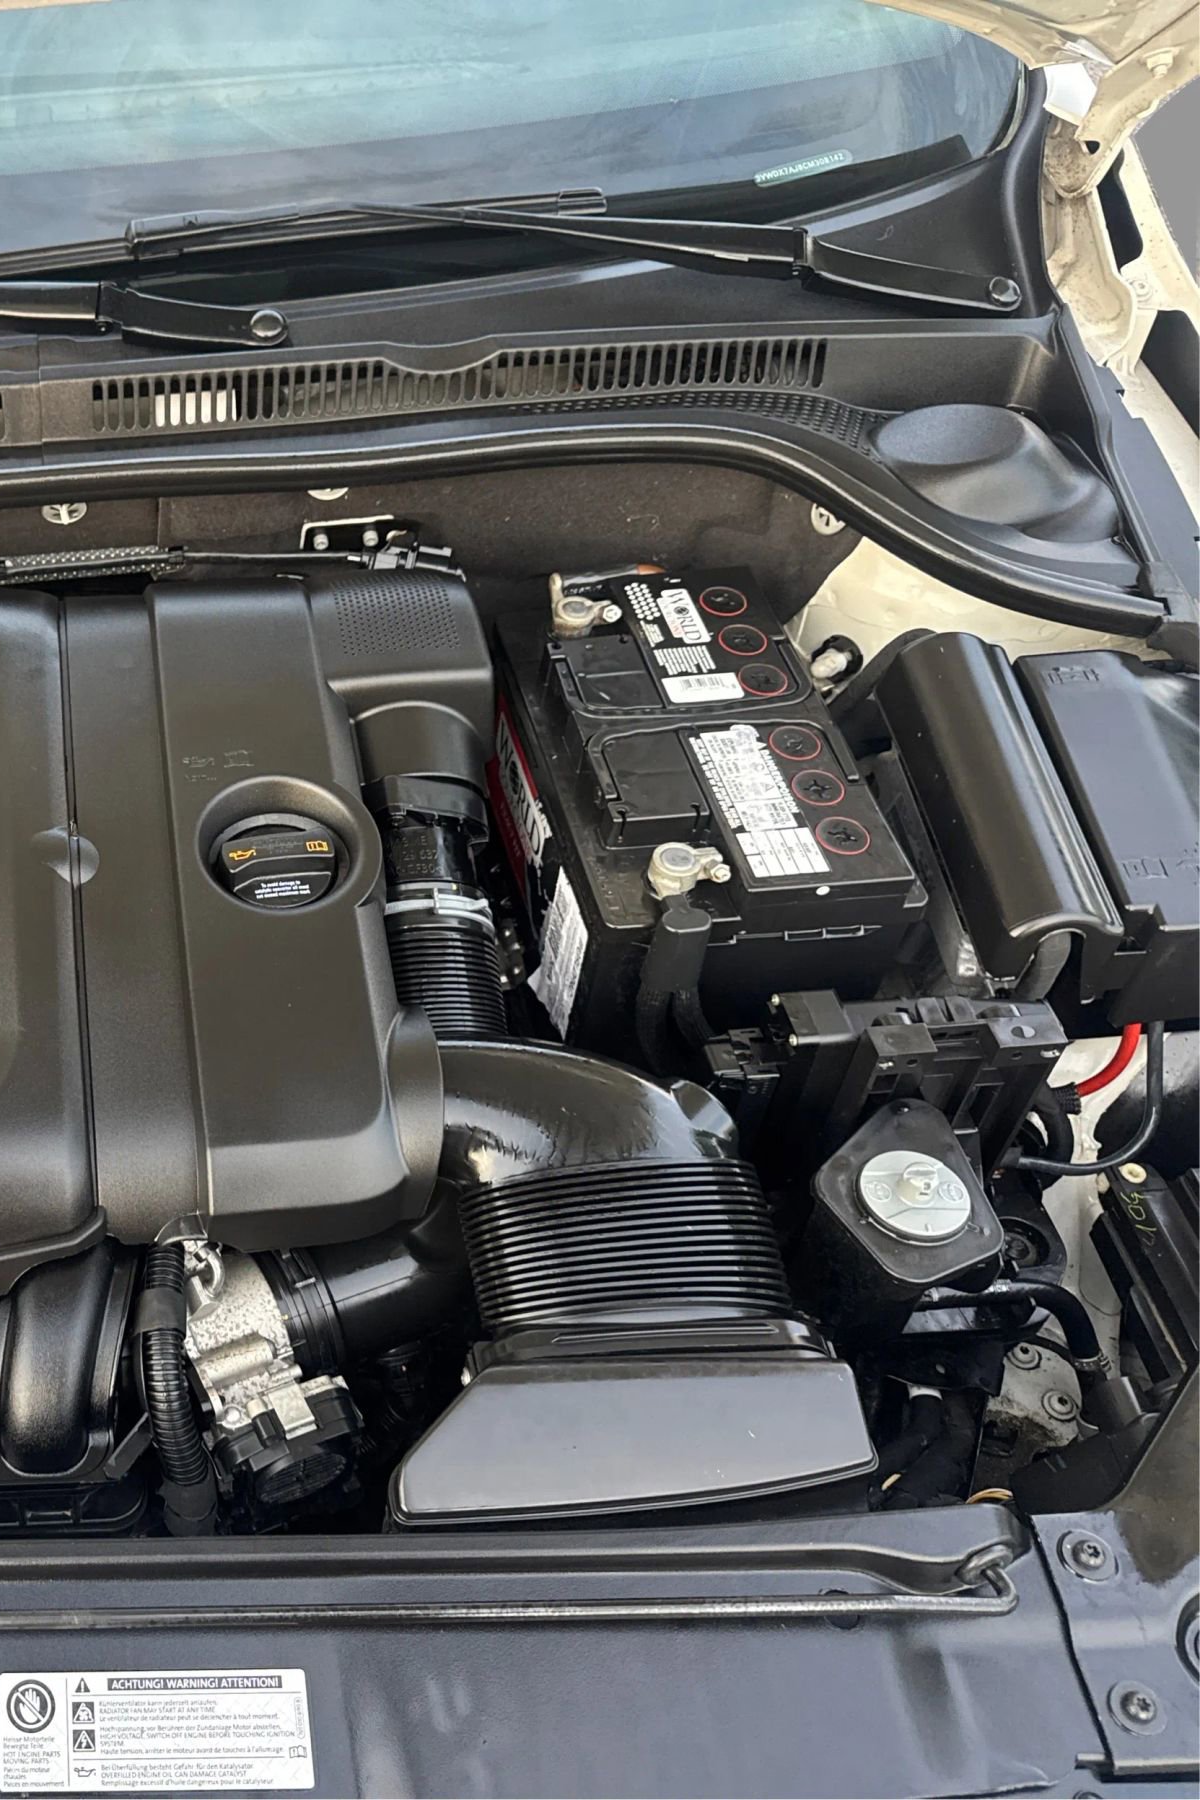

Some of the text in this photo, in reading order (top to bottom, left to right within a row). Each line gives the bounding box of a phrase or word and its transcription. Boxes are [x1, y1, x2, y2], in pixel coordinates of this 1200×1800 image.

[667, 591, 702, 641] WORLD
[500, 719, 541, 856] WORLD
[111, 1676, 279, 1690] ACHTUNG! WARNING! ATTENTION!
